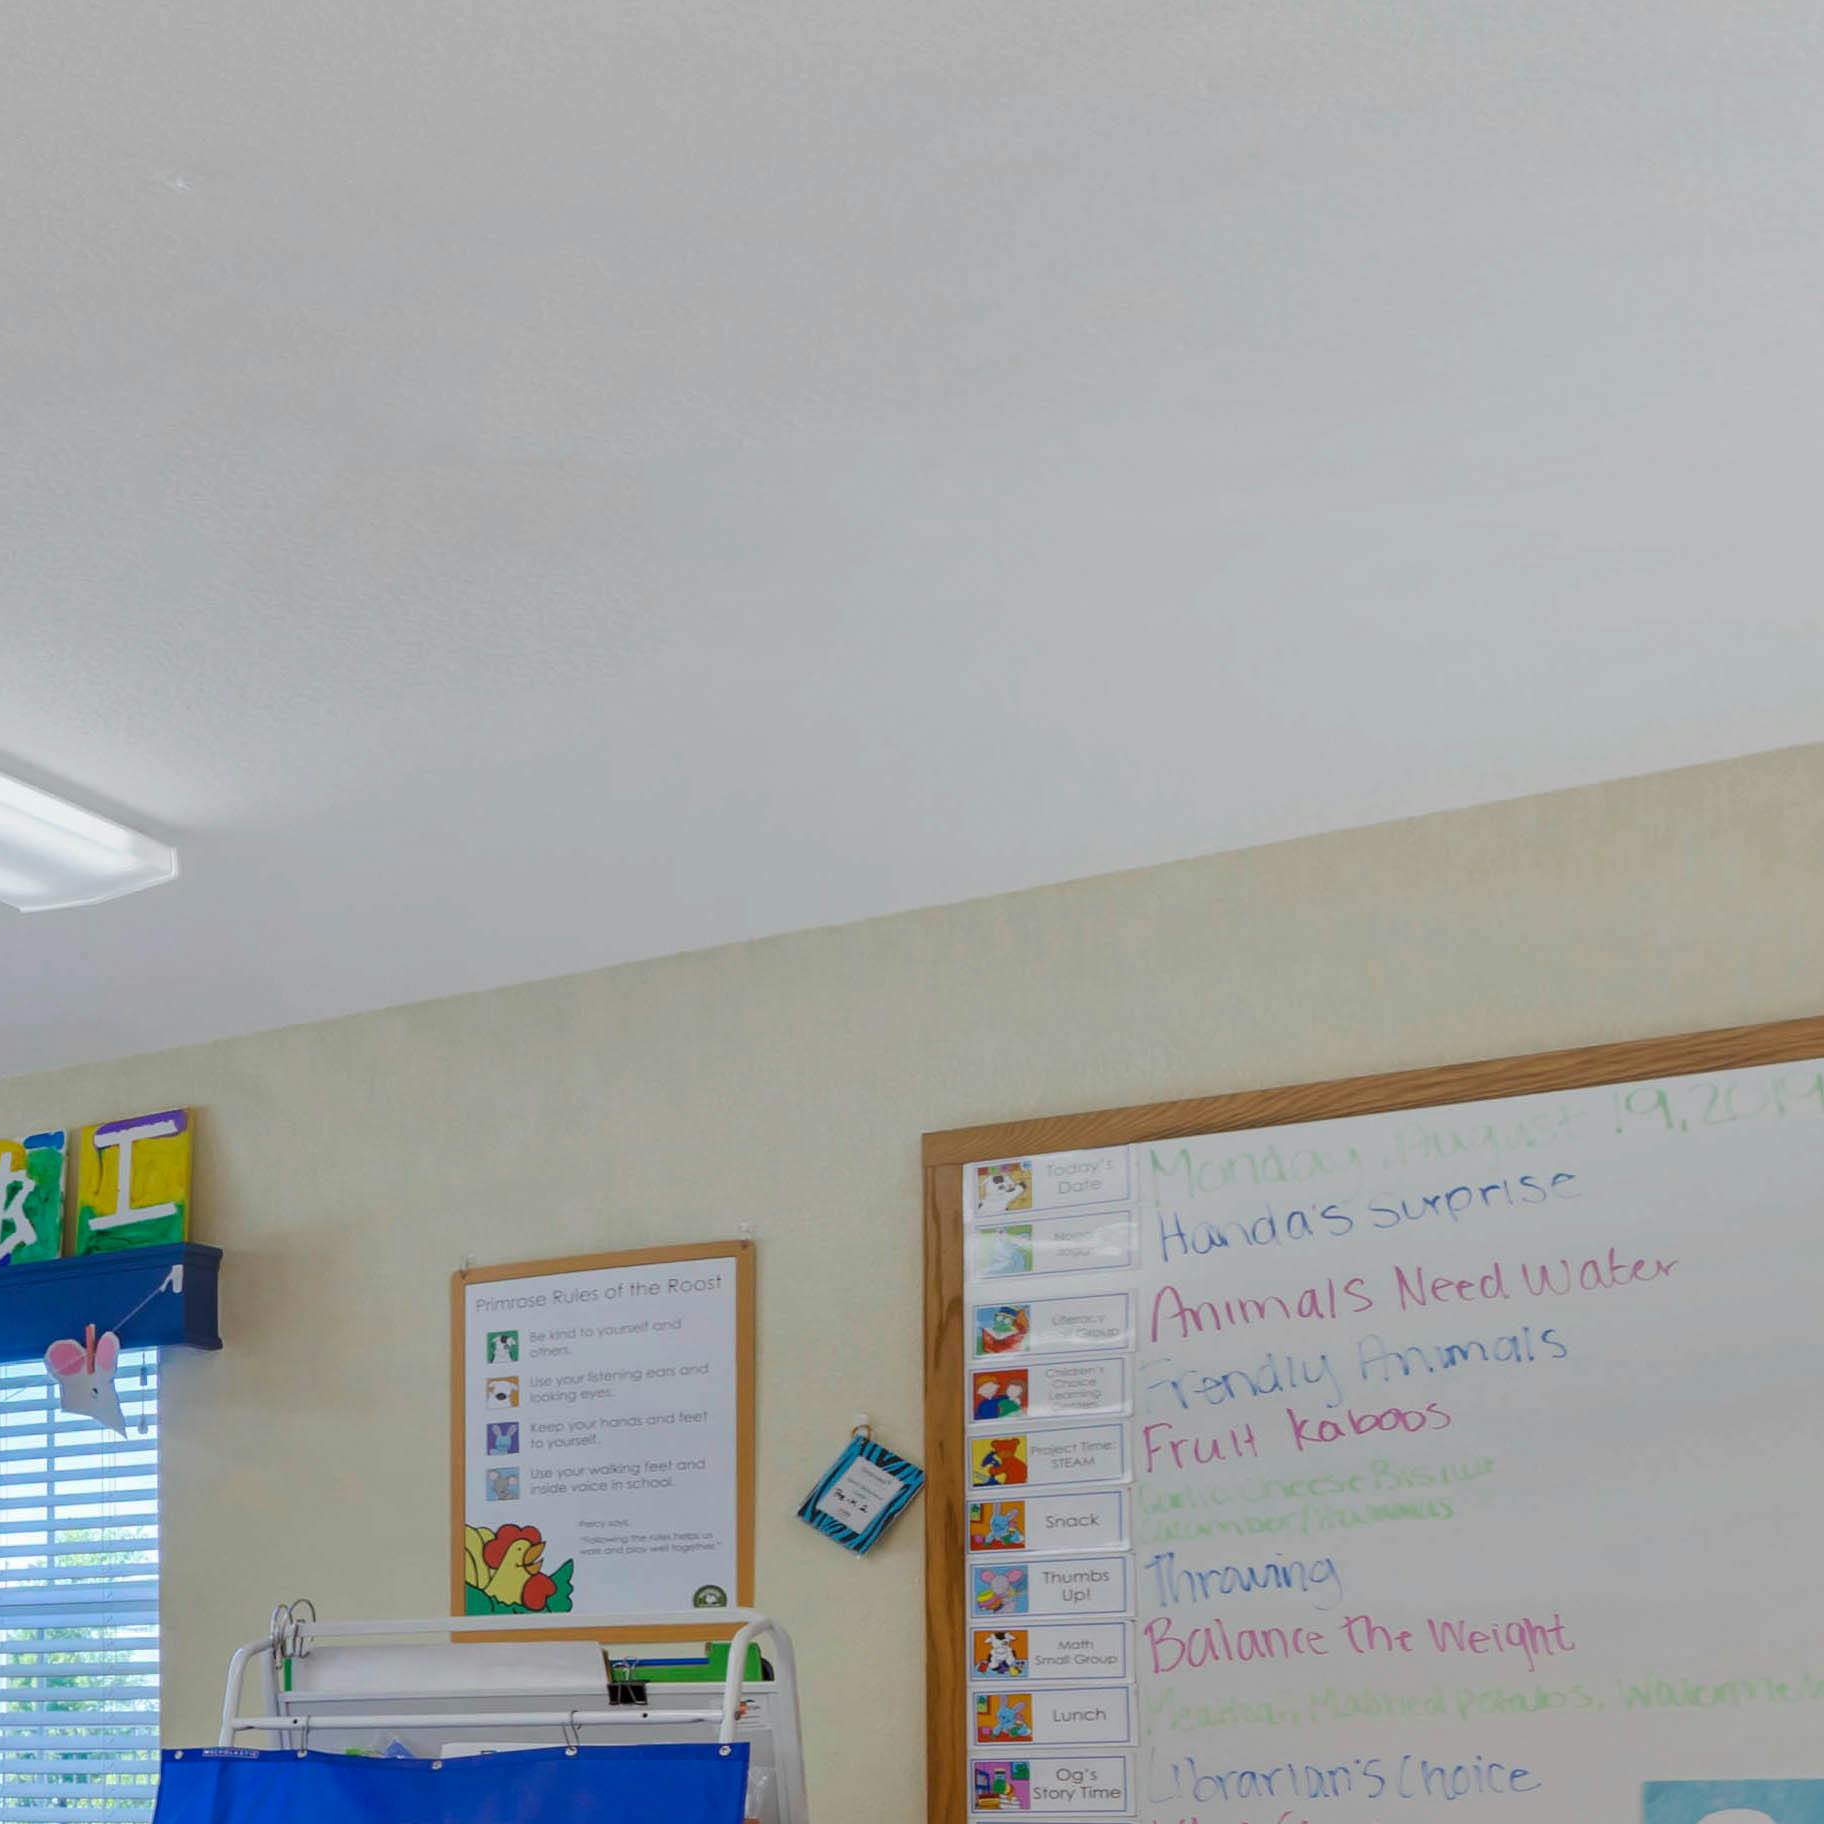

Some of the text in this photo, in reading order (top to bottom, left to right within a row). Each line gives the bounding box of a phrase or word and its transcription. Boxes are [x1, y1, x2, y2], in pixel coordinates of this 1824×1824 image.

[1058, 1180, 1101, 1195] Date
[1156, 1203, 1353, 1263] Handa's
[476, 1275, 723, 1313] Primrose Rules of the Roost
[1152, 1277, 1373, 1343] Animals
[1394, 1262, 1510, 1311] Need
[530, 1331, 546, 1344] Be
[580, 1325, 594, 1338] to
[597, 1321, 649, 1338] yourself
[652, 1318, 682, 1331] and
[1356, 1327, 1568, 1381] Animals
[529, 1362, 710, 1388] Use your listening ears and
[529, 1410, 709, 1435] Keep your hands and feet
[529, 1436, 545, 1449] to
[529, 1458, 706, 1480] Use your walking feet and
[1052, 1456, 1096, 1470] STEAM
[529, 1482, 568, 1496] inside
[570, 1480, 609, 1493] voice
[610, 1478, 624, 1491] in
[1044, 1512, 1102, 1529] Snack
[1042, 1569, 1110, 1585] Thumbs
[1061, 1587, 1093, 1605] Up!
[1057, 1640, 1095, 1651] Math
[1145, 1616, 1329, 1674] Balance
[1427, 1611, 1576, 1672] Weight
[1034, 1653, 1120, 1667] Small Group
[1052, 1709, 1107, 1723] Lunch
[1055, 1768, 1099, 1784] Og's
[1399, 1753, 1543, 1800] Choice
[1032, 1786, 1122, 1802] Story Time
